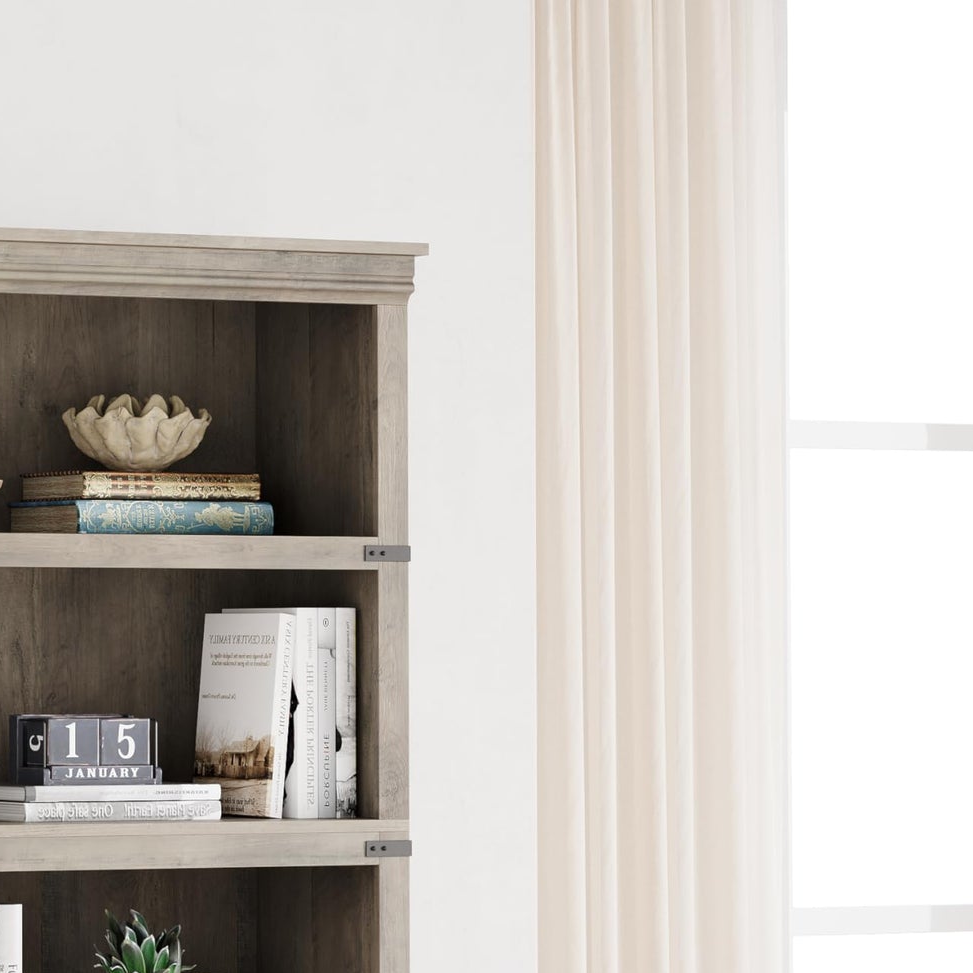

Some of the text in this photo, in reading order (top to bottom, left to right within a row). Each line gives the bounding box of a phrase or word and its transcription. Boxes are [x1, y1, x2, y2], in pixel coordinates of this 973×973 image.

[65, 722, 136, 759] 1 5
[65, 767, 140, 779] JANUARY
